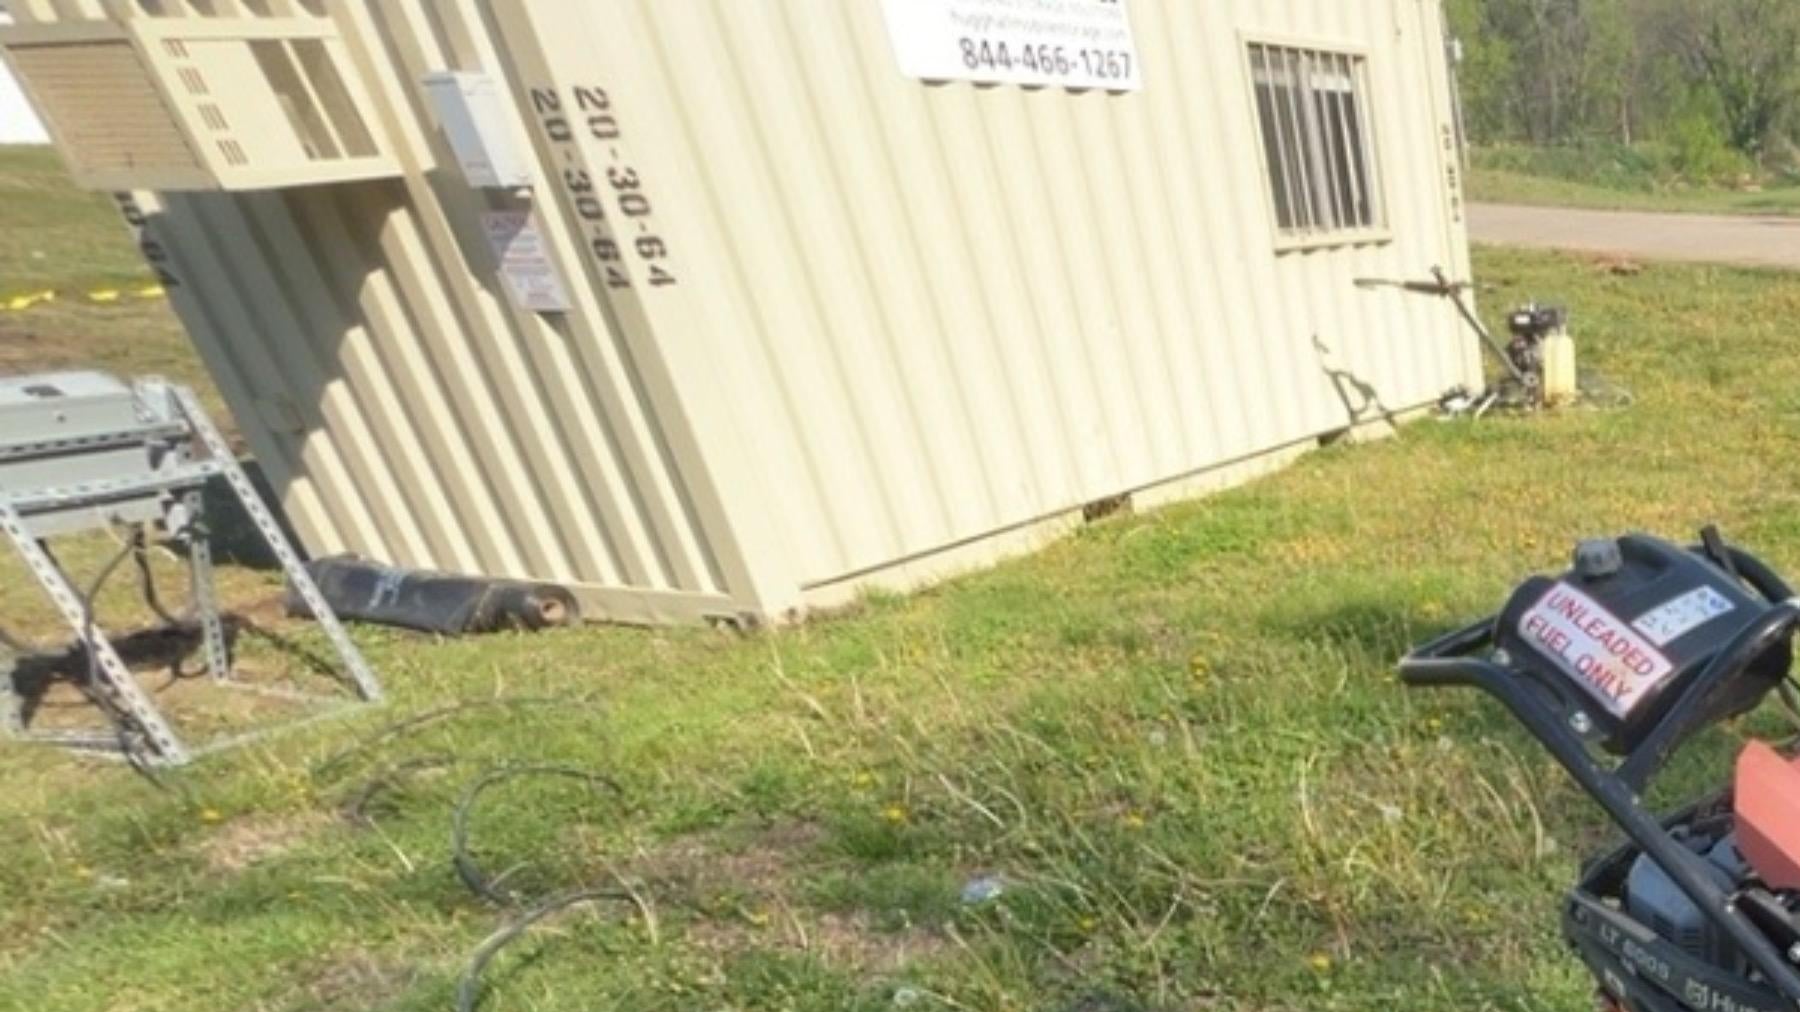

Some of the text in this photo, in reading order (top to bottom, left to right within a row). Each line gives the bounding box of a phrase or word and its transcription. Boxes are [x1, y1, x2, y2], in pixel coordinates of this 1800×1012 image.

[958, 36, 1132, 80] 844-466-1267
[530, 87, 631, 290] 20-30-64
[572, 85, 677, 288] 20-30-64
[1526, 614, 1634, 703] FUEL ONLY
[1546, 592, 1655, 677] UNLEADED
